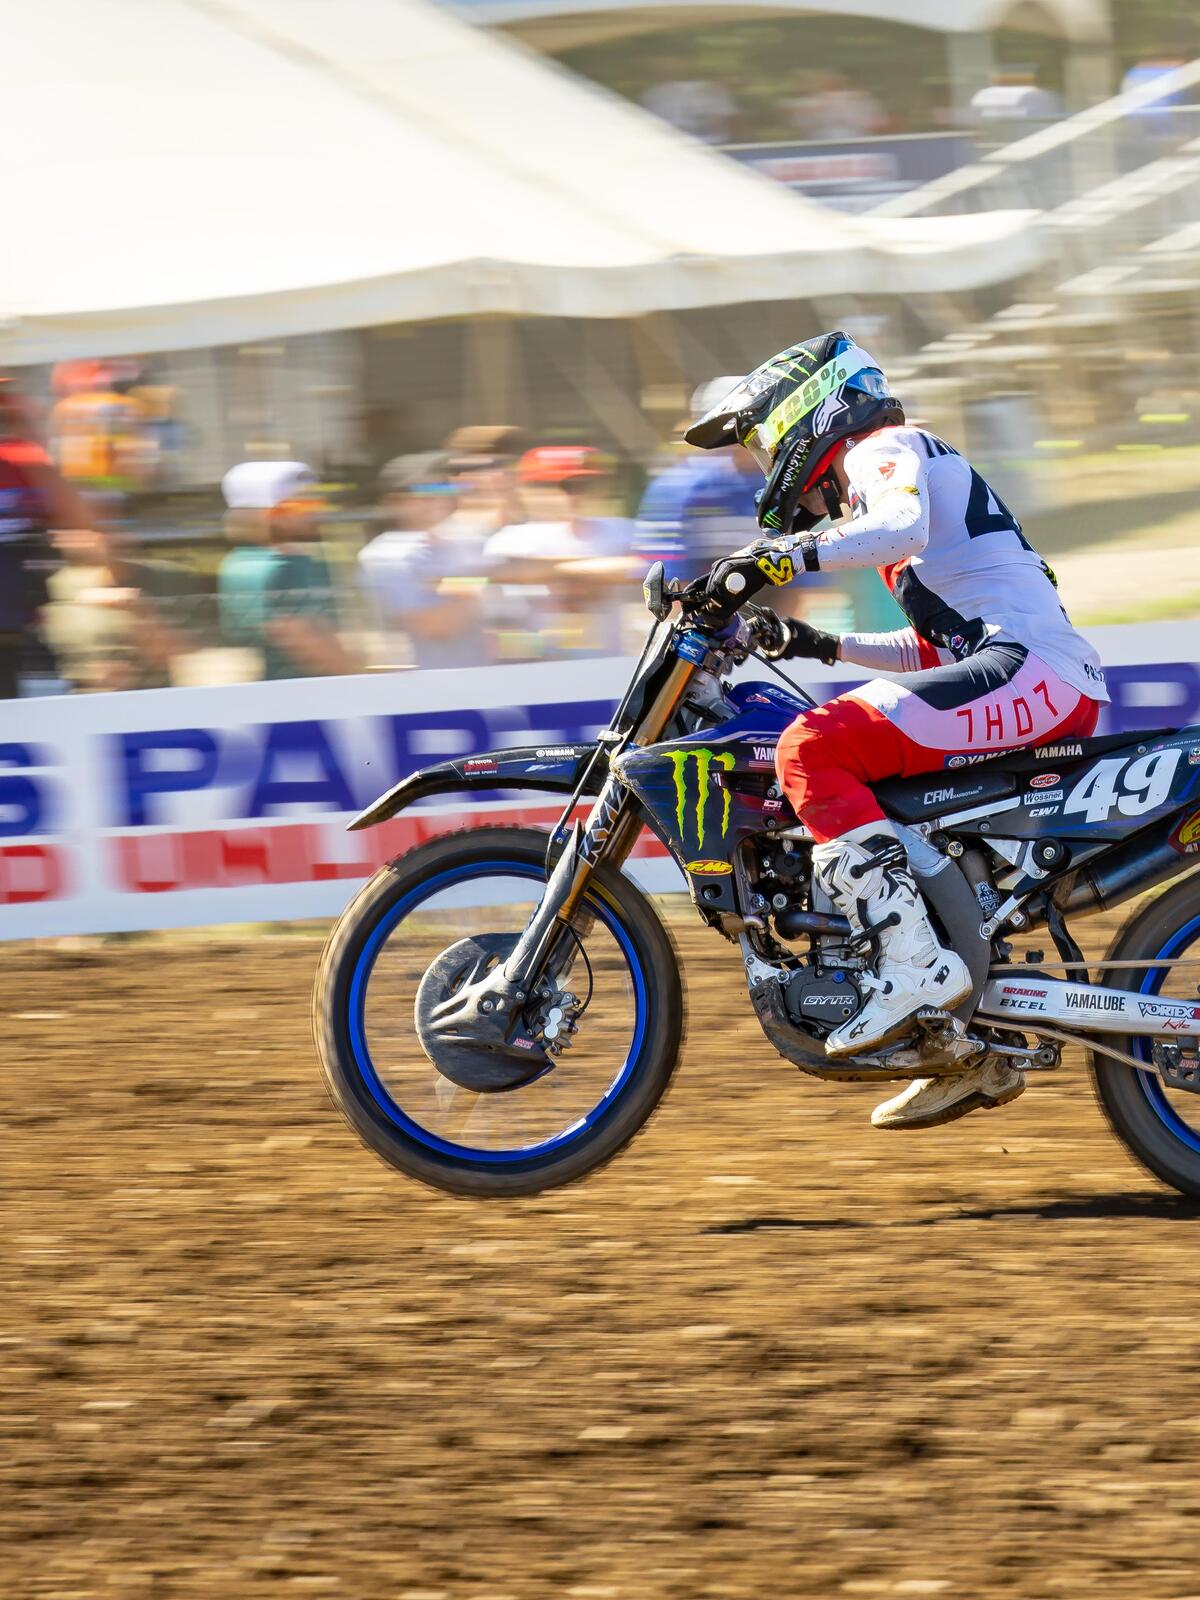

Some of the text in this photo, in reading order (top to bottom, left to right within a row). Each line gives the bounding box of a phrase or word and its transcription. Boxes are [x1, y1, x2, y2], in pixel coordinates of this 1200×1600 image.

[781, 437, 812, 492] MONSTER
[545, 748, 575, 757] YAMAHA
[753, 747, 776, 761] YAM
[1034, 743, 1083, 759] YAMAHA
[1063, 748, 1182, 823] 49
[687, 861, 732, 872] FMF
[1002, 985, 1048, 998] BRAKING
[803, 995, 855, 1006] GYTR
[1000, 998, 1048, 1011] EXCEL
[1065, 992, 1127, 1012] YAMALUBE
[1138, 1001, 1195, 1020] VORTEX
